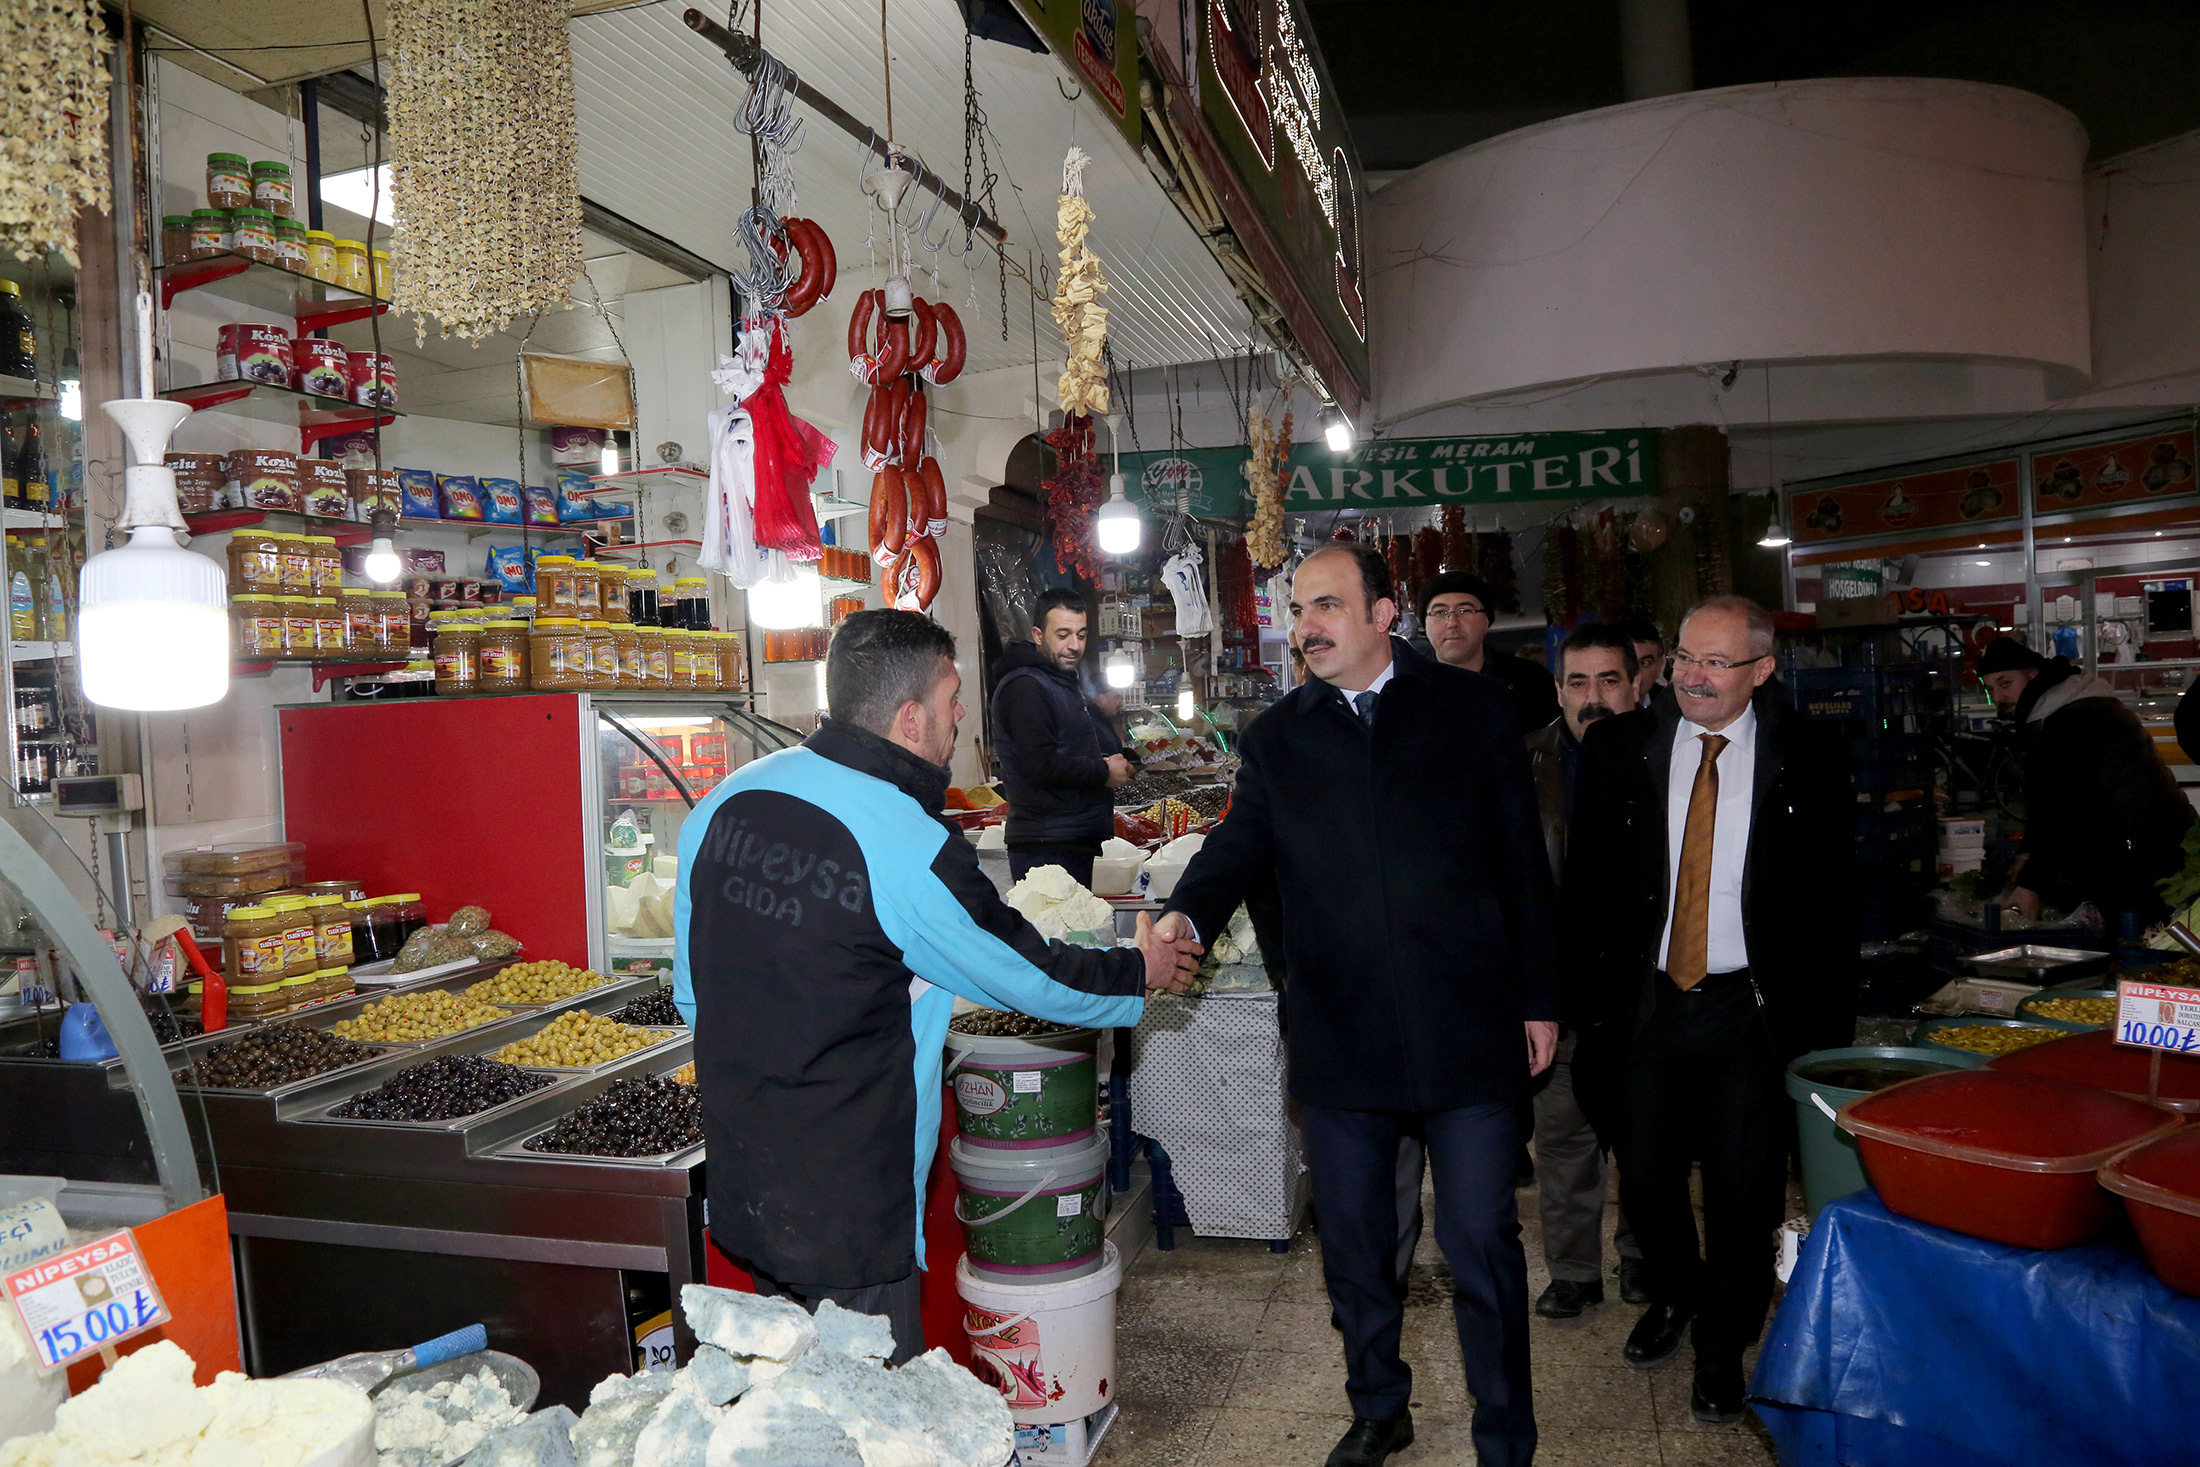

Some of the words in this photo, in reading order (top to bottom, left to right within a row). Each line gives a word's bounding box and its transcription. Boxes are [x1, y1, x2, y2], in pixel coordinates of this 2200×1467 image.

[1431, 441, 1536, 458] MERAM
[165, 458, 197, 470] ozlu
[255, 455, 298, 469] Kozlu
[409, 485, 433, 498] OMO
[451, 490, 474, 503] OMO
[497, 494, 518, 507] OMO
[533, 497, 554, 509] OMO
[503, 564, 524, 576] OMO
[723, 875, 803, 927] GIDA
[2126, 985, 2200, 1002] NİPEYSA
[960, 1079, 994, 1097] ÖZHAN
[14, 1241, 127, 1293] NİPEYSA
[110, 1265, 139, 1284] TULUM
